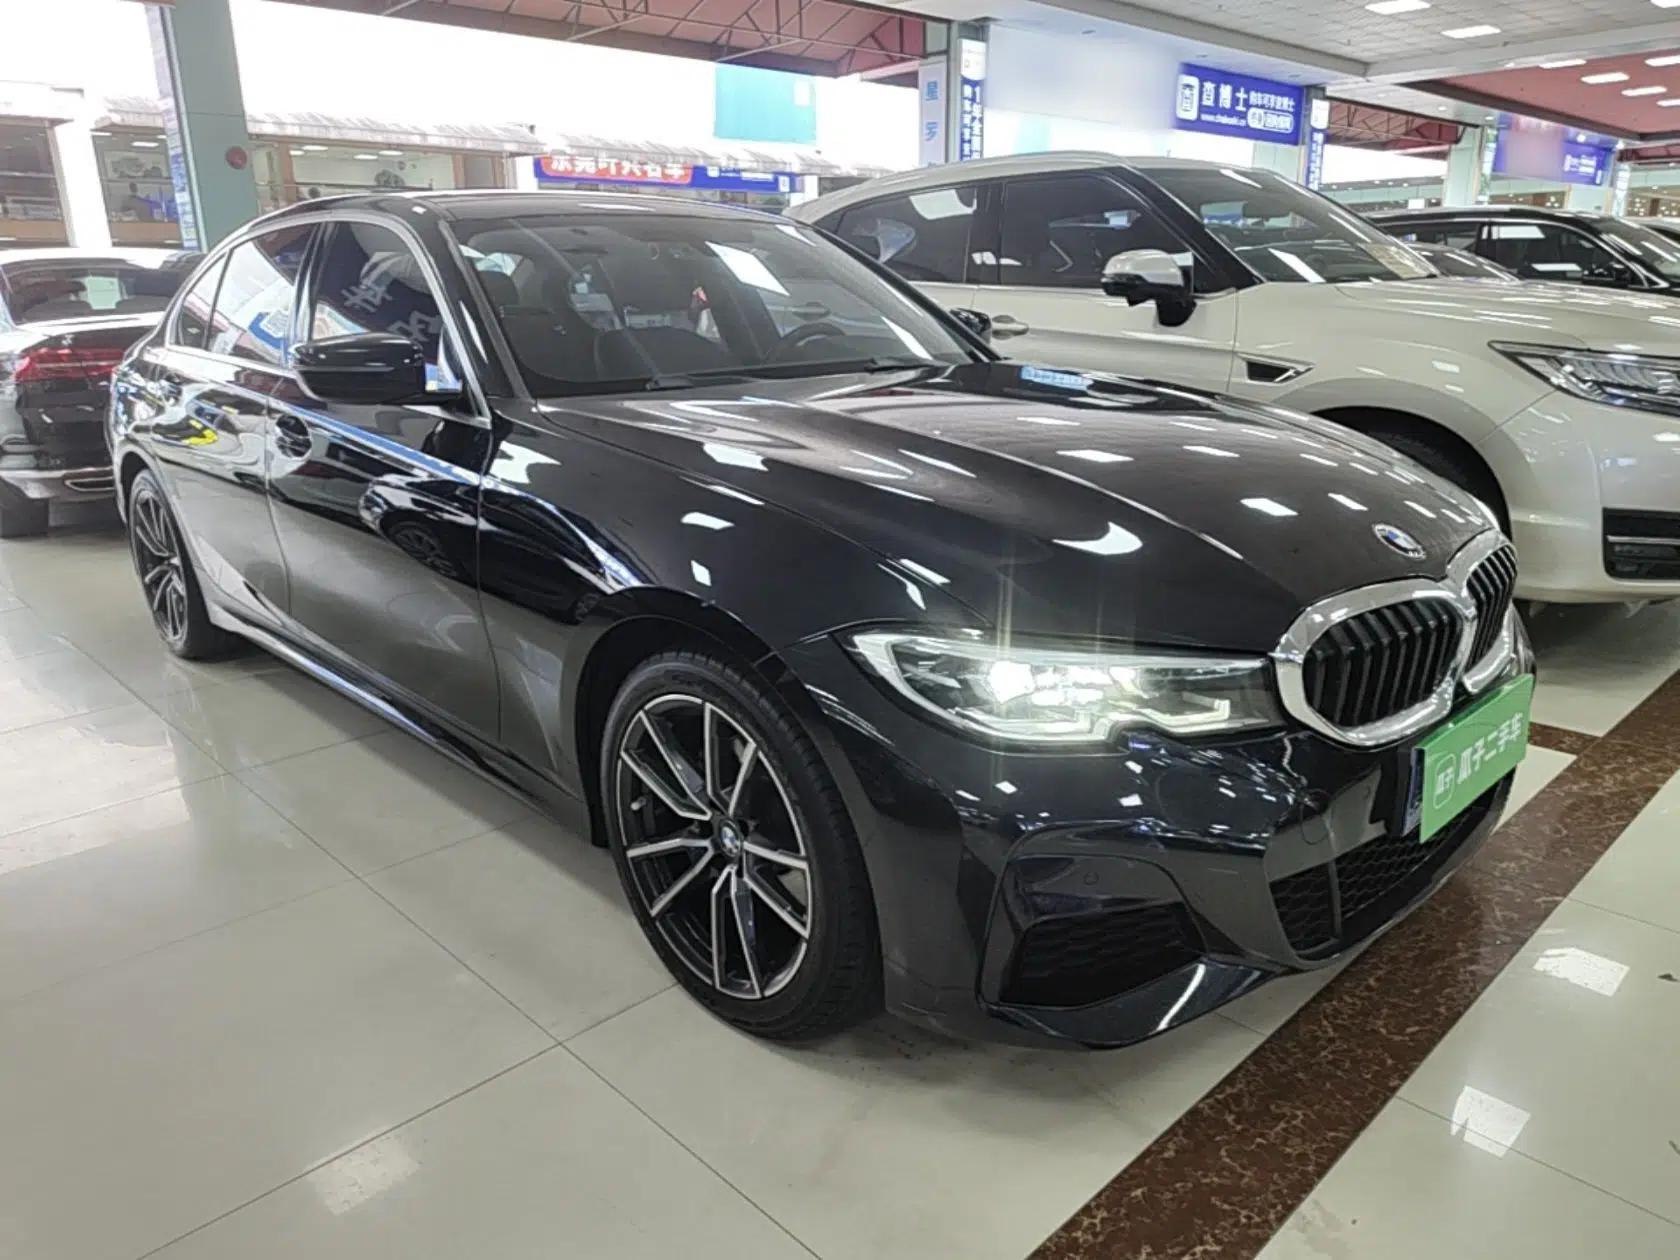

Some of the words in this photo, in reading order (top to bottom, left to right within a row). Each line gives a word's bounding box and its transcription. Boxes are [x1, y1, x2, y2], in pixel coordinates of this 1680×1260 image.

[1201, 81, 1248, 111] 查博士
[1456, 712, 1523, 784] 瓜子二手车
